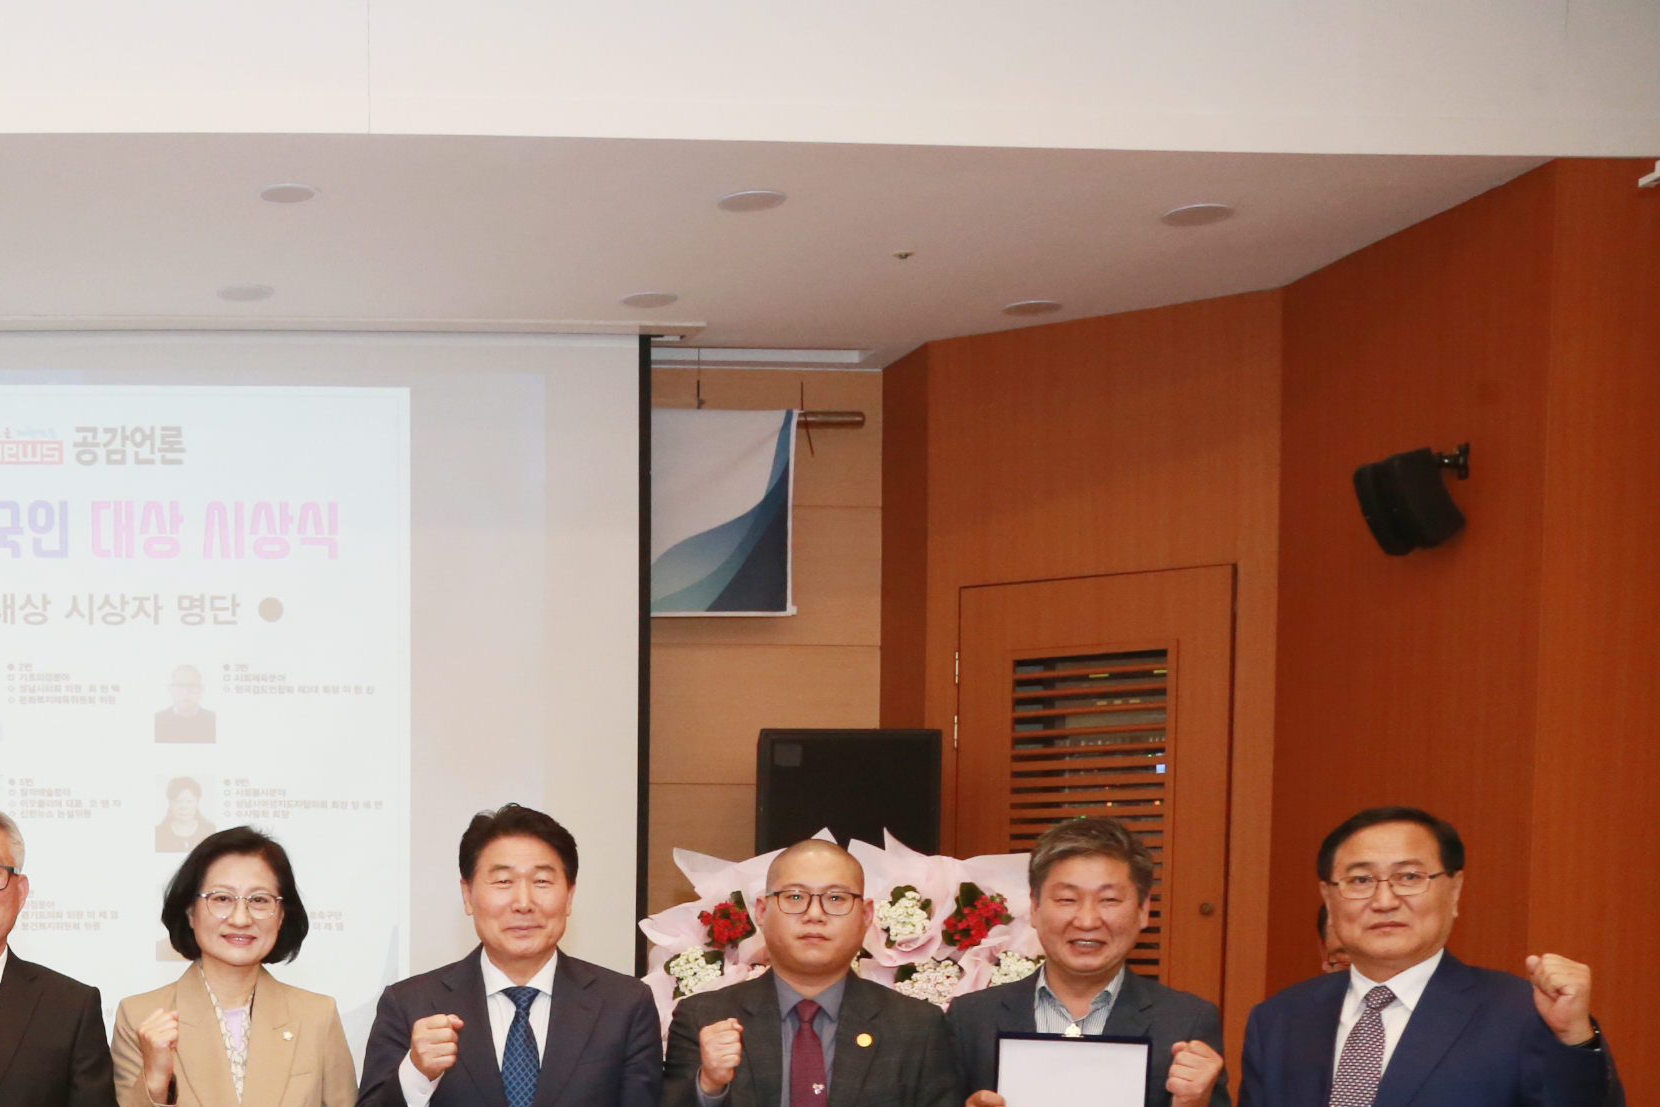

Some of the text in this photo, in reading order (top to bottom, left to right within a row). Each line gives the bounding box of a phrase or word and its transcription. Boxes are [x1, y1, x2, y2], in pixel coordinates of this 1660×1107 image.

[73, 425, 186, 466] 공감언론
[90, 499, 185, 560] 대상
[204, 500, 341, 561] 시상식
[63, 592, 163, 626] 시상자
[176, 592, 240, 626] 명단
